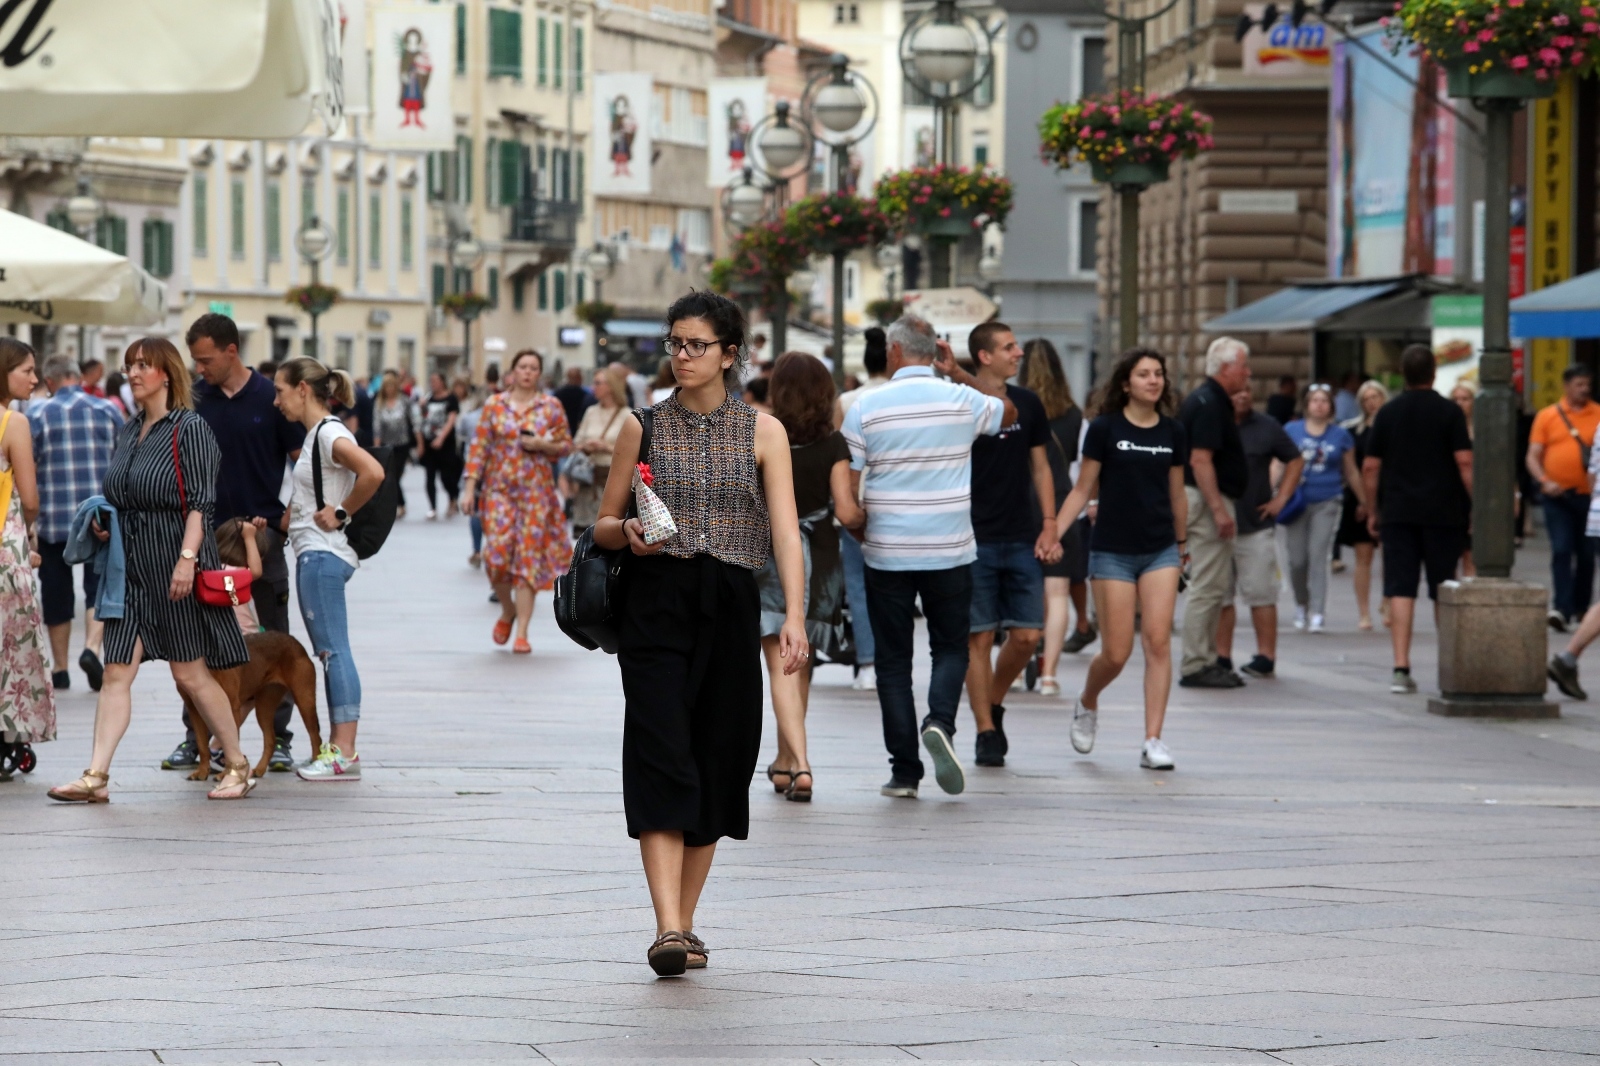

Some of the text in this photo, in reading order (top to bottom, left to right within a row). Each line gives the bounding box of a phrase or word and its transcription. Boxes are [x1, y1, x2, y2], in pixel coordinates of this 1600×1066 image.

[1543, 97, 1561, 288] APPY HOM
[1116, 440, 1173, 455] Champion
